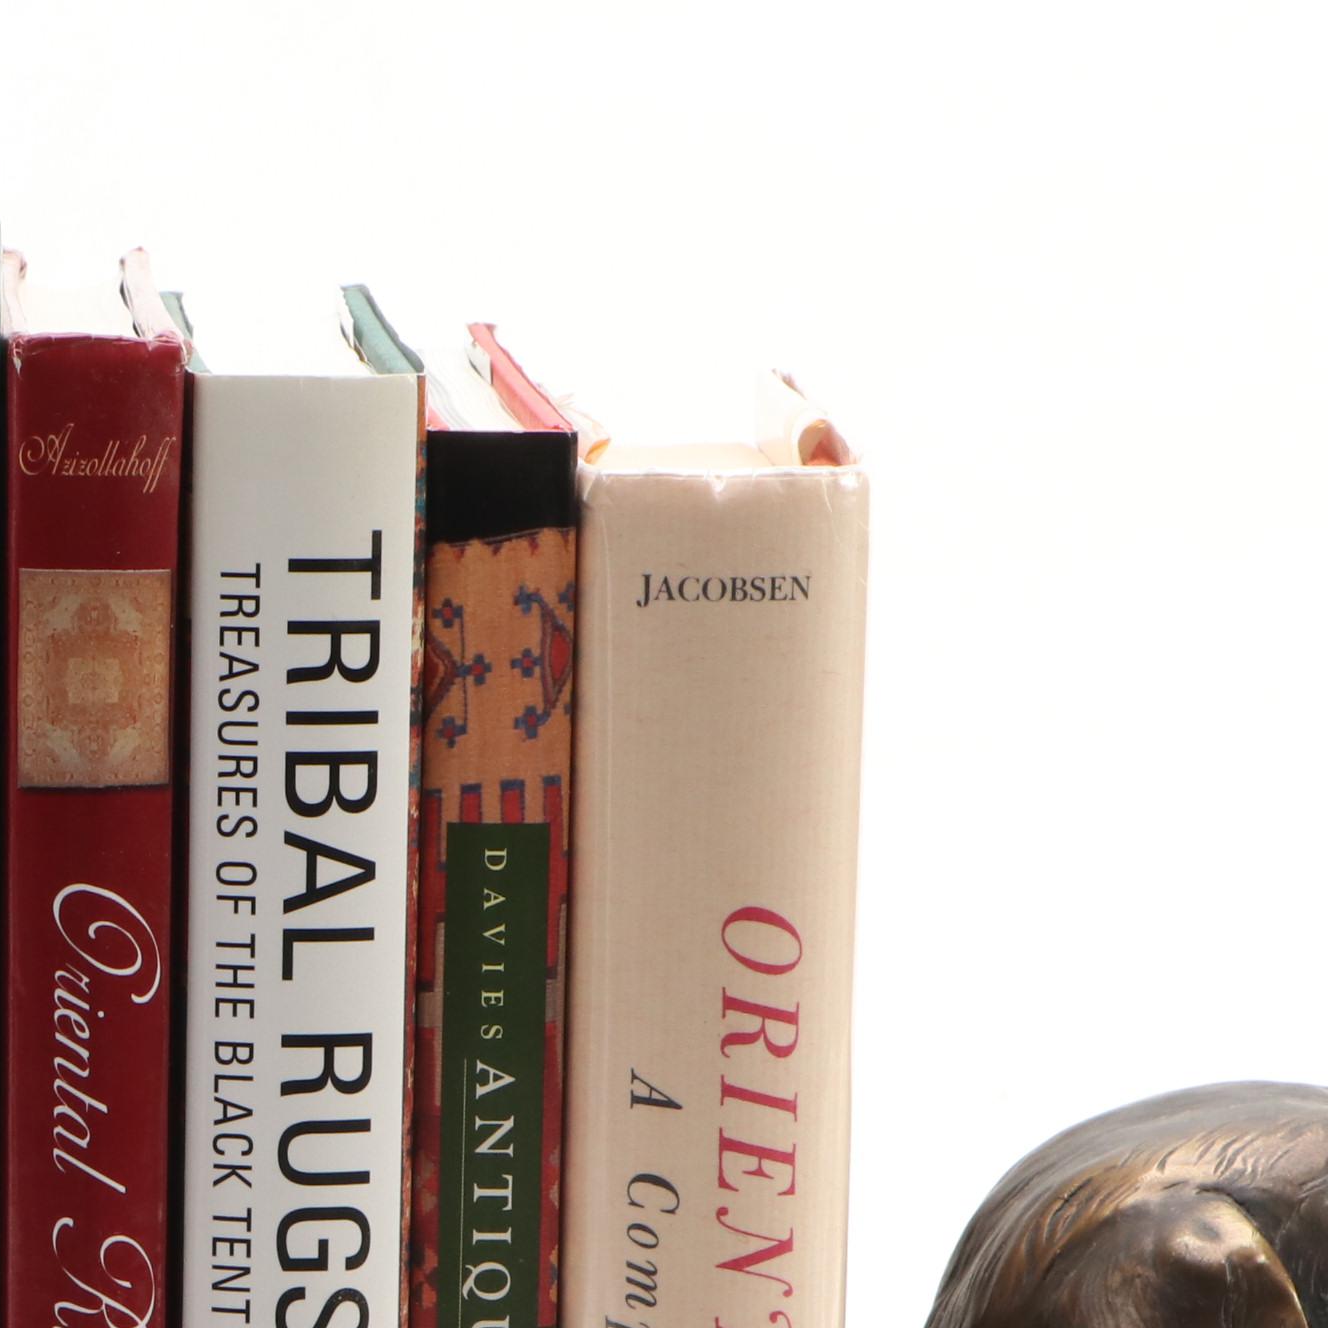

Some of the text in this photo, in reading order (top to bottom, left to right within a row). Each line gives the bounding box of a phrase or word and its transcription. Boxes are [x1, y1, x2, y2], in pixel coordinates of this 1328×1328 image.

[636, 572, 812, 609] JACOBSEN
[281, 530, 382, 980] TRIBAL
[53, 883, 160, 1193] Oriental
[210, 563, 261, 1324] TREASURES OF THE BLACK TENT
[479, 847, 508, 1040] DAVIES
[628, 1069, 683, 1110] A
